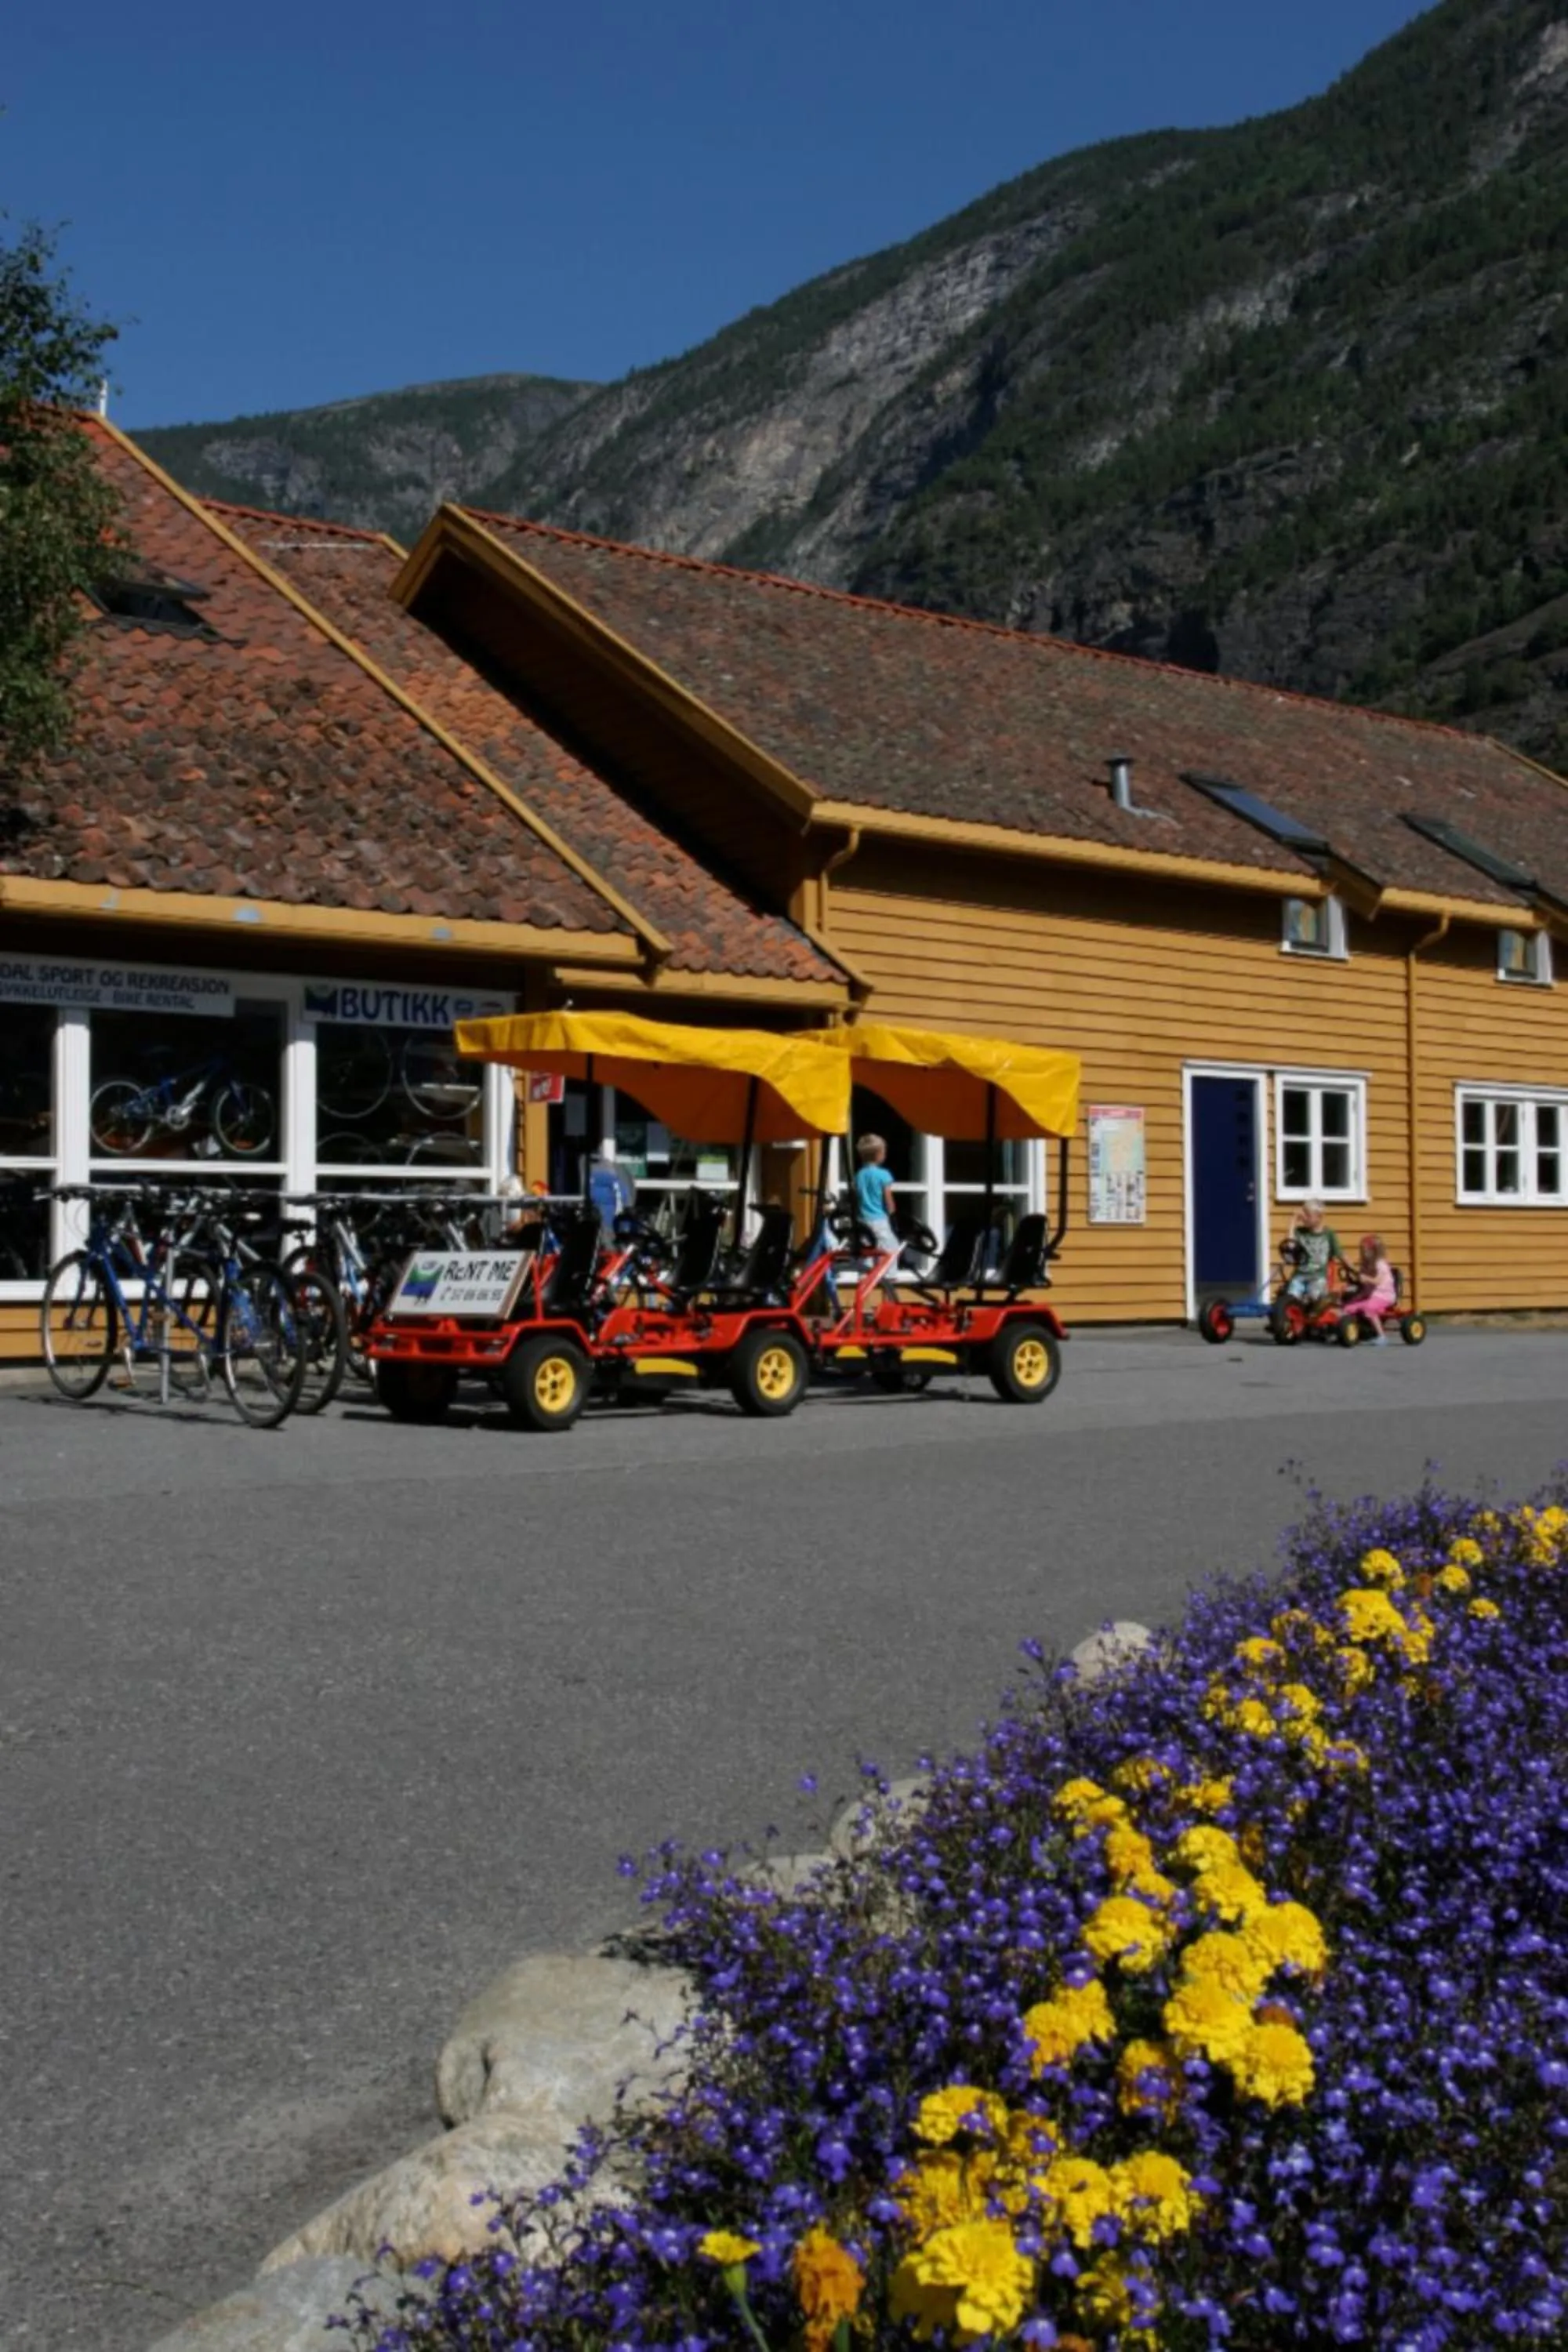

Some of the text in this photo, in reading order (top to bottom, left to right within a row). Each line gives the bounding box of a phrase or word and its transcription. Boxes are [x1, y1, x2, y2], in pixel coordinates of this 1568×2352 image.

[38, 965, 95, 985] SPORT
[100, 970, 123, 987] OG
[127, 971, 230, 994] REKREASJON
[340, 987, 449, 1025] BUTIKK
[487, 1261, 517, 1281] ME
